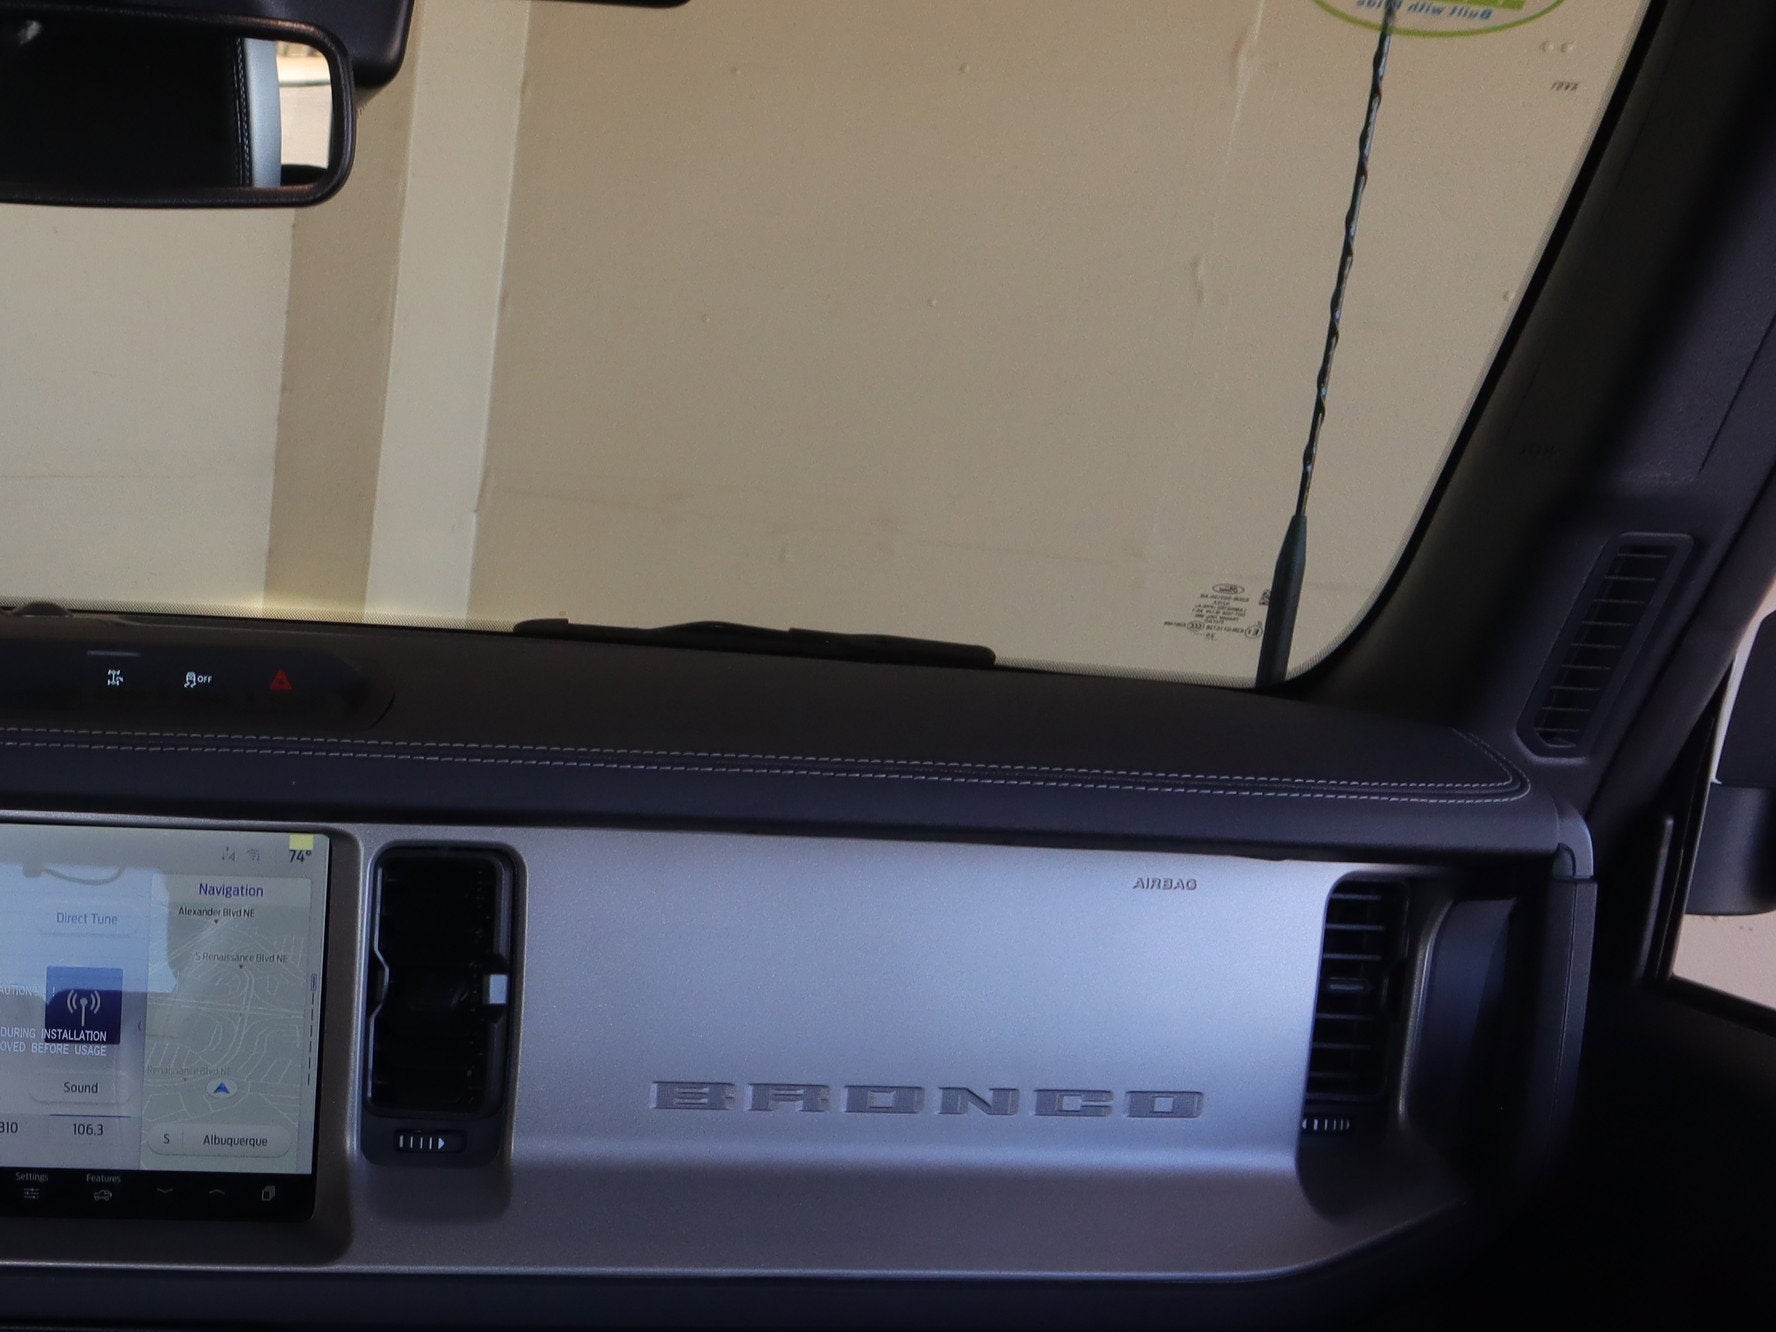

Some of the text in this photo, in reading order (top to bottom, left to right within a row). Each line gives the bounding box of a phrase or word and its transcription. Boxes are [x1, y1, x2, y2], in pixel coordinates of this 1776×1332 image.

[197, 674, 212, 683] OFF
[198, 883, 264, 898] Navigation
[1132, 877, 1198, 891] AIRBAG
[56, 912, 118, 925] Direct Tune
[223, 908, 242, 917] Blvd
[243, 909, 255, 918] NE
[1, 1027, 36, 1038] DURING
[41, 1028, 107, 1042] INSTALLATION
[31, 1042, 69, 1054] BEFORE
[75, 1044, 107, 1056] USAGE
[63, 1081, 98, 1095] Sound
[649, 1081, 1204, 1119] BRONCO
[73, 1123, 104, 1136] 106.3
[163, 1133, 170, 1145] S
[203, 1134, 268, 1148] Albuquerque
[15, 1172, 49, 1184] Settings
[86, 1173, 121, 1183] Features
